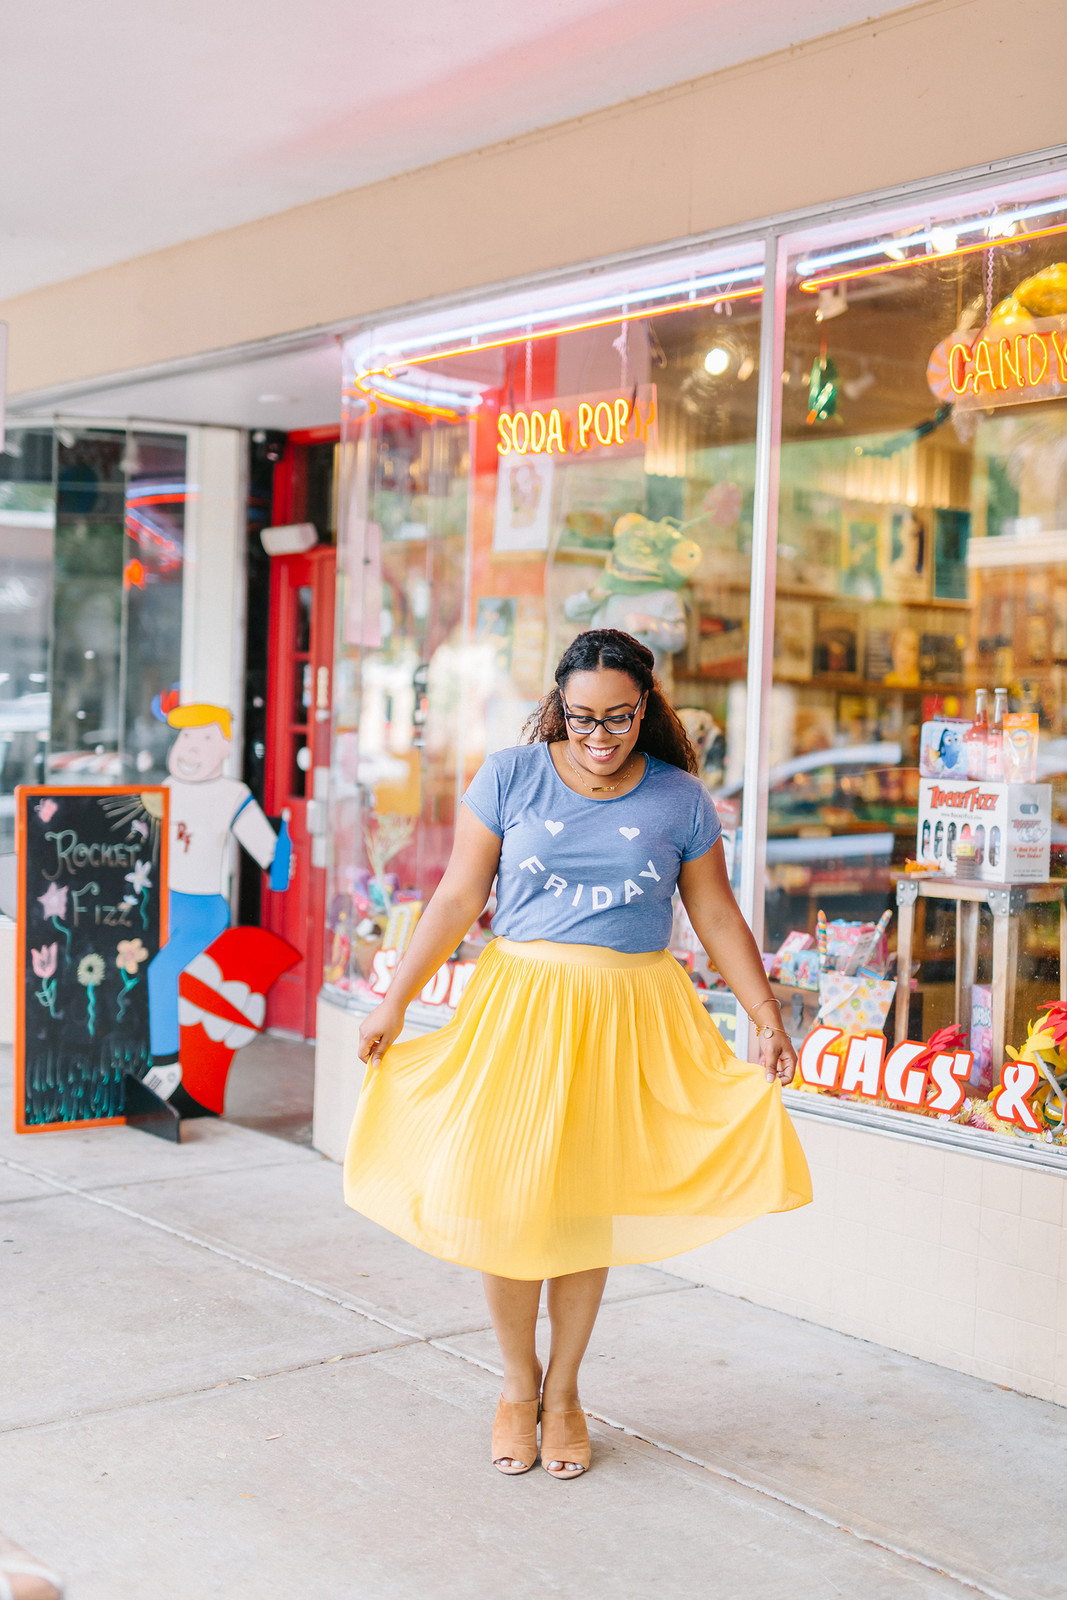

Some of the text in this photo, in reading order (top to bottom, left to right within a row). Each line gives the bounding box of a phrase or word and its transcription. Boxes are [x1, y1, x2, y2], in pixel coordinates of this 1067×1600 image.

[948, 329, 1067, 395] CANDY
[497, 398, 629, 456] SODA POP
[518, 856, 661, 910] FRIDAY
[799, 1025, 974, 1115] GAGS
[992, 1061, 1043, 1133] &
